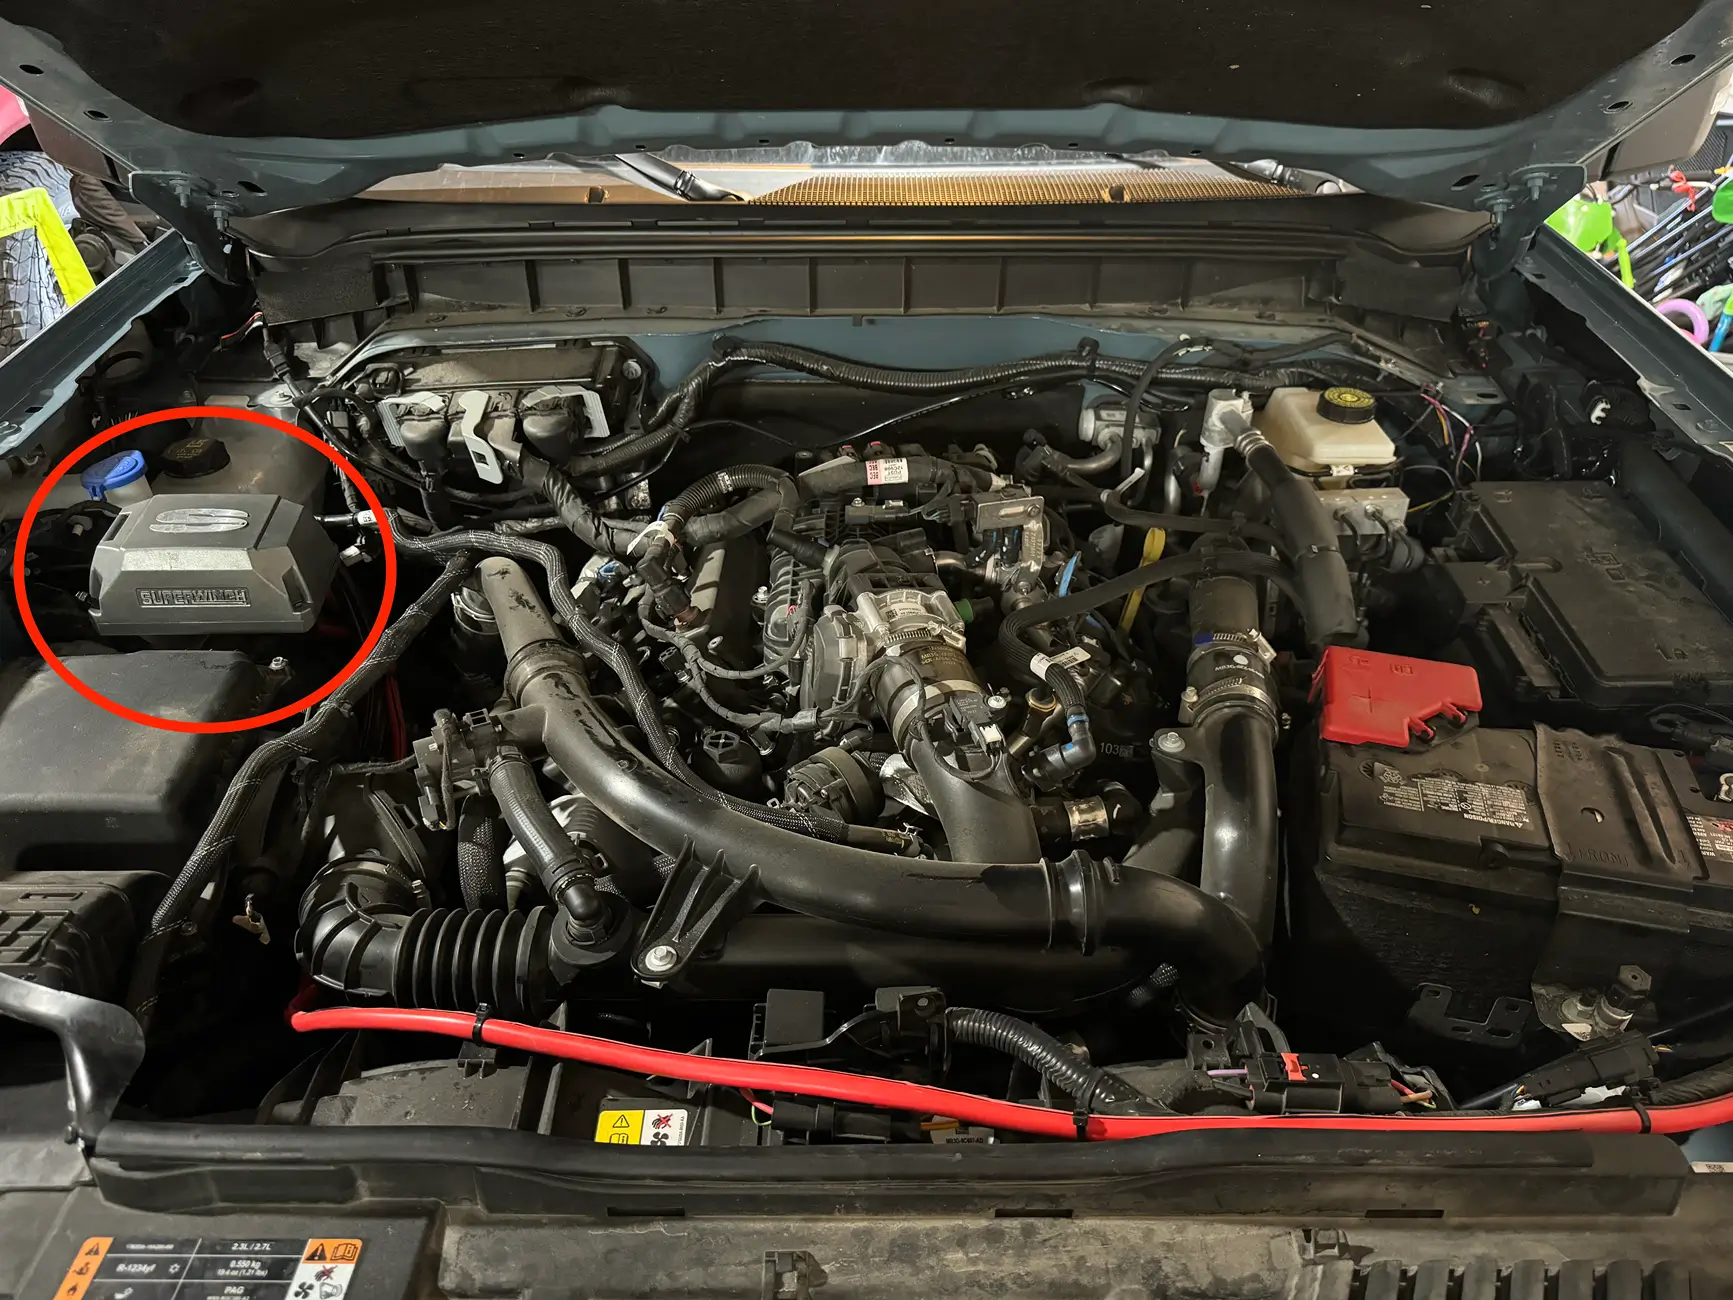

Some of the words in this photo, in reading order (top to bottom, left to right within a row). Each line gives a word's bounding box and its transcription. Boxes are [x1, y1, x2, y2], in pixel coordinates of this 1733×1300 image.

[140, 589, 248, 605] SUPERWINCH
[1100, 741, 1120, 755] 103
[231, 1242, 248, 1250] 2.3L
[254, 1242, 272, 1250] 2.7L
[116, 1263, 157, 1273] R-1234yf
[224, 1286, 245, 1294] PAG
